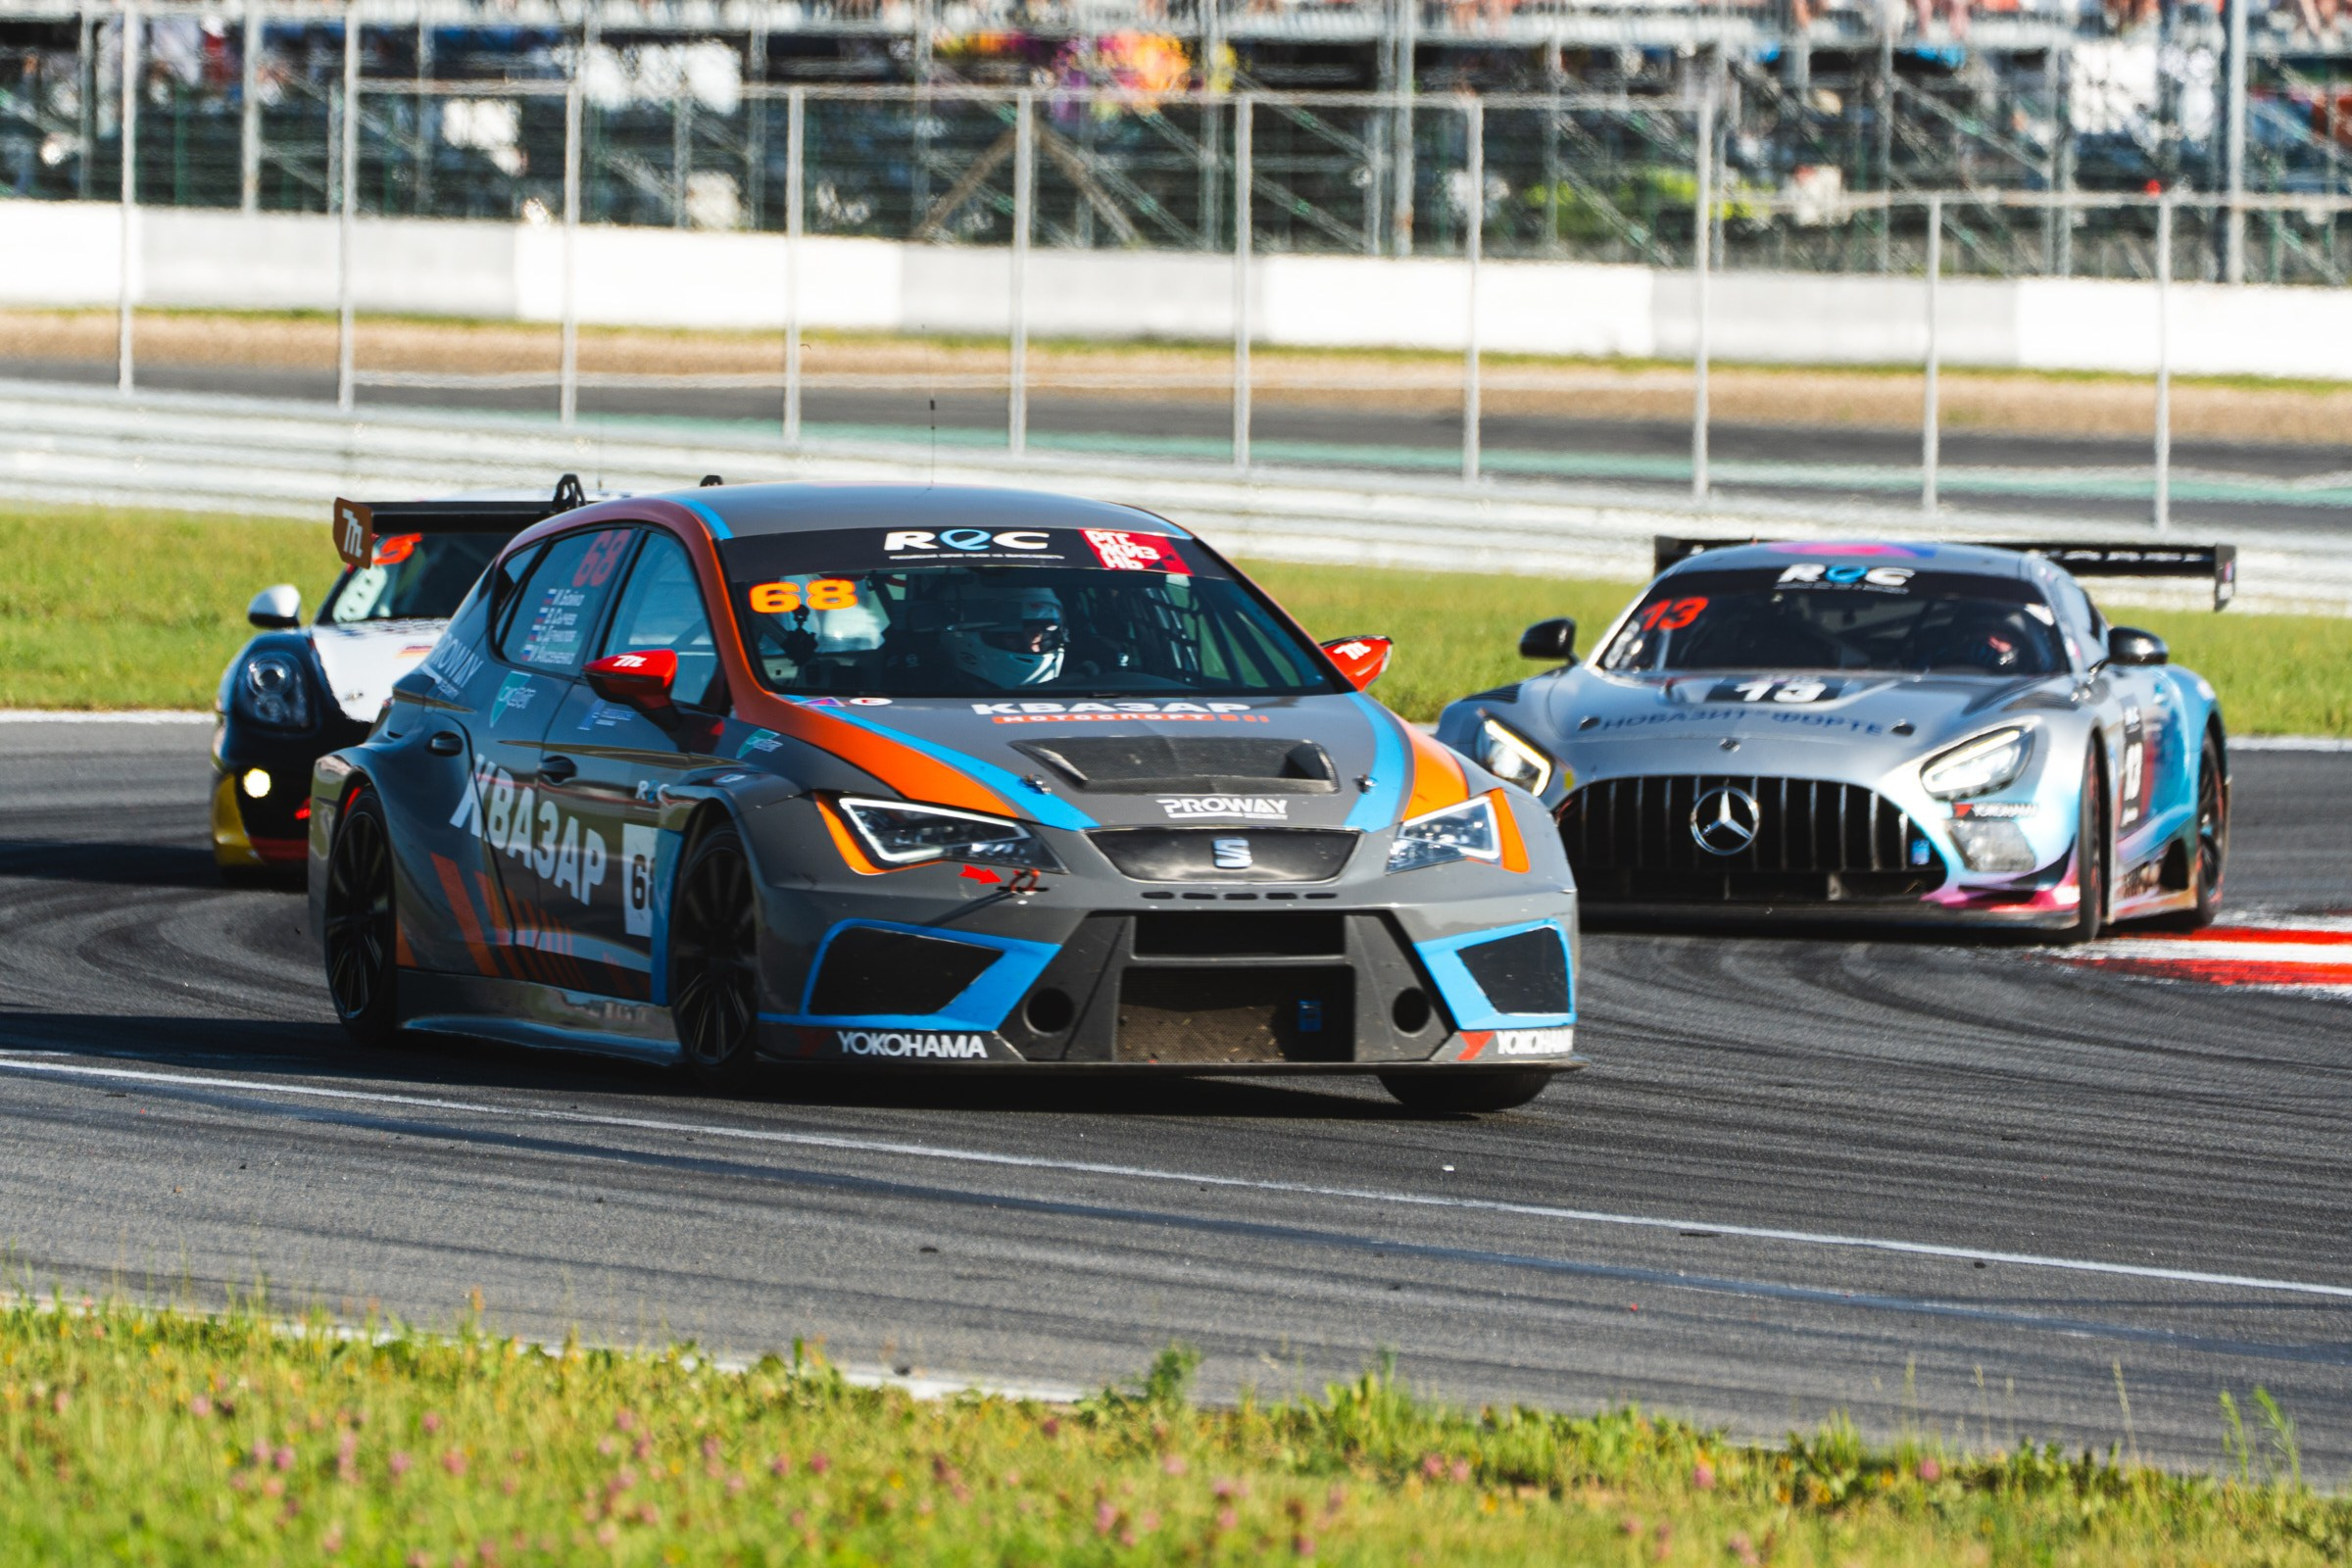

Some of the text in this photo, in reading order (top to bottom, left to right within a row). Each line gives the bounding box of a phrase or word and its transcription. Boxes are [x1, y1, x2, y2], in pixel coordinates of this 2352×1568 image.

[572, 529, 632, 587] 68
[749, 578, 858, 613] 68
[1642, 596, 1709, 631] 13
[970, 703, 1251, 715] КВАЗАР
[1156, 798, 1288, 814] PROWAY
[449, 754, 607, 906] КВАЗАР
[837, 1031, 988, 1057] YOKOHAMA
